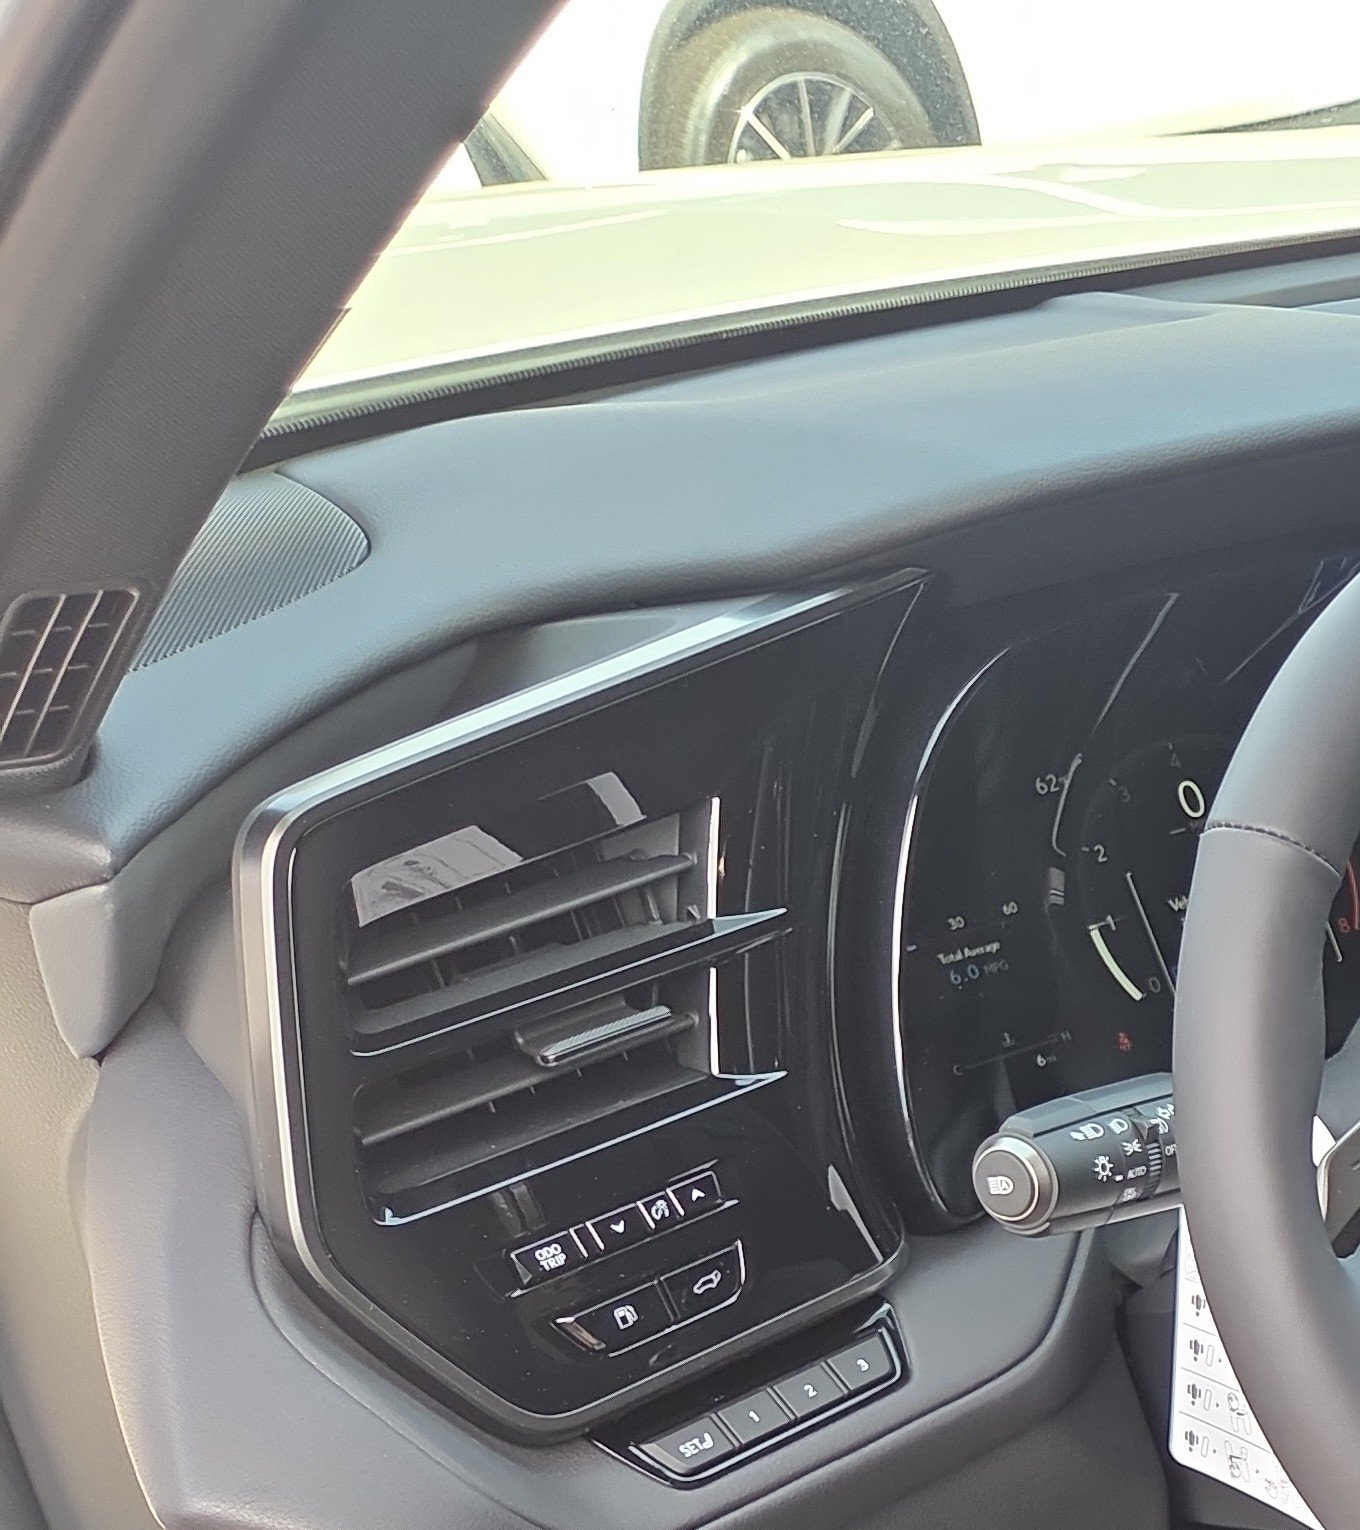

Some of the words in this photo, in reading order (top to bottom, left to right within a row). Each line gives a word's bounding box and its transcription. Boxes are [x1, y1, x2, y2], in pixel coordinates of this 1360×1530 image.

[1178, 780, 1206, 818] 0
[534, 1242, 562, 1262] ODO
[540, 1252, 567, 1272] TRIP
[856, 1357, 870, 1372] 3
[803, 1383, 818, 1398] 2
[748, 1409, 761, 1423] 1
